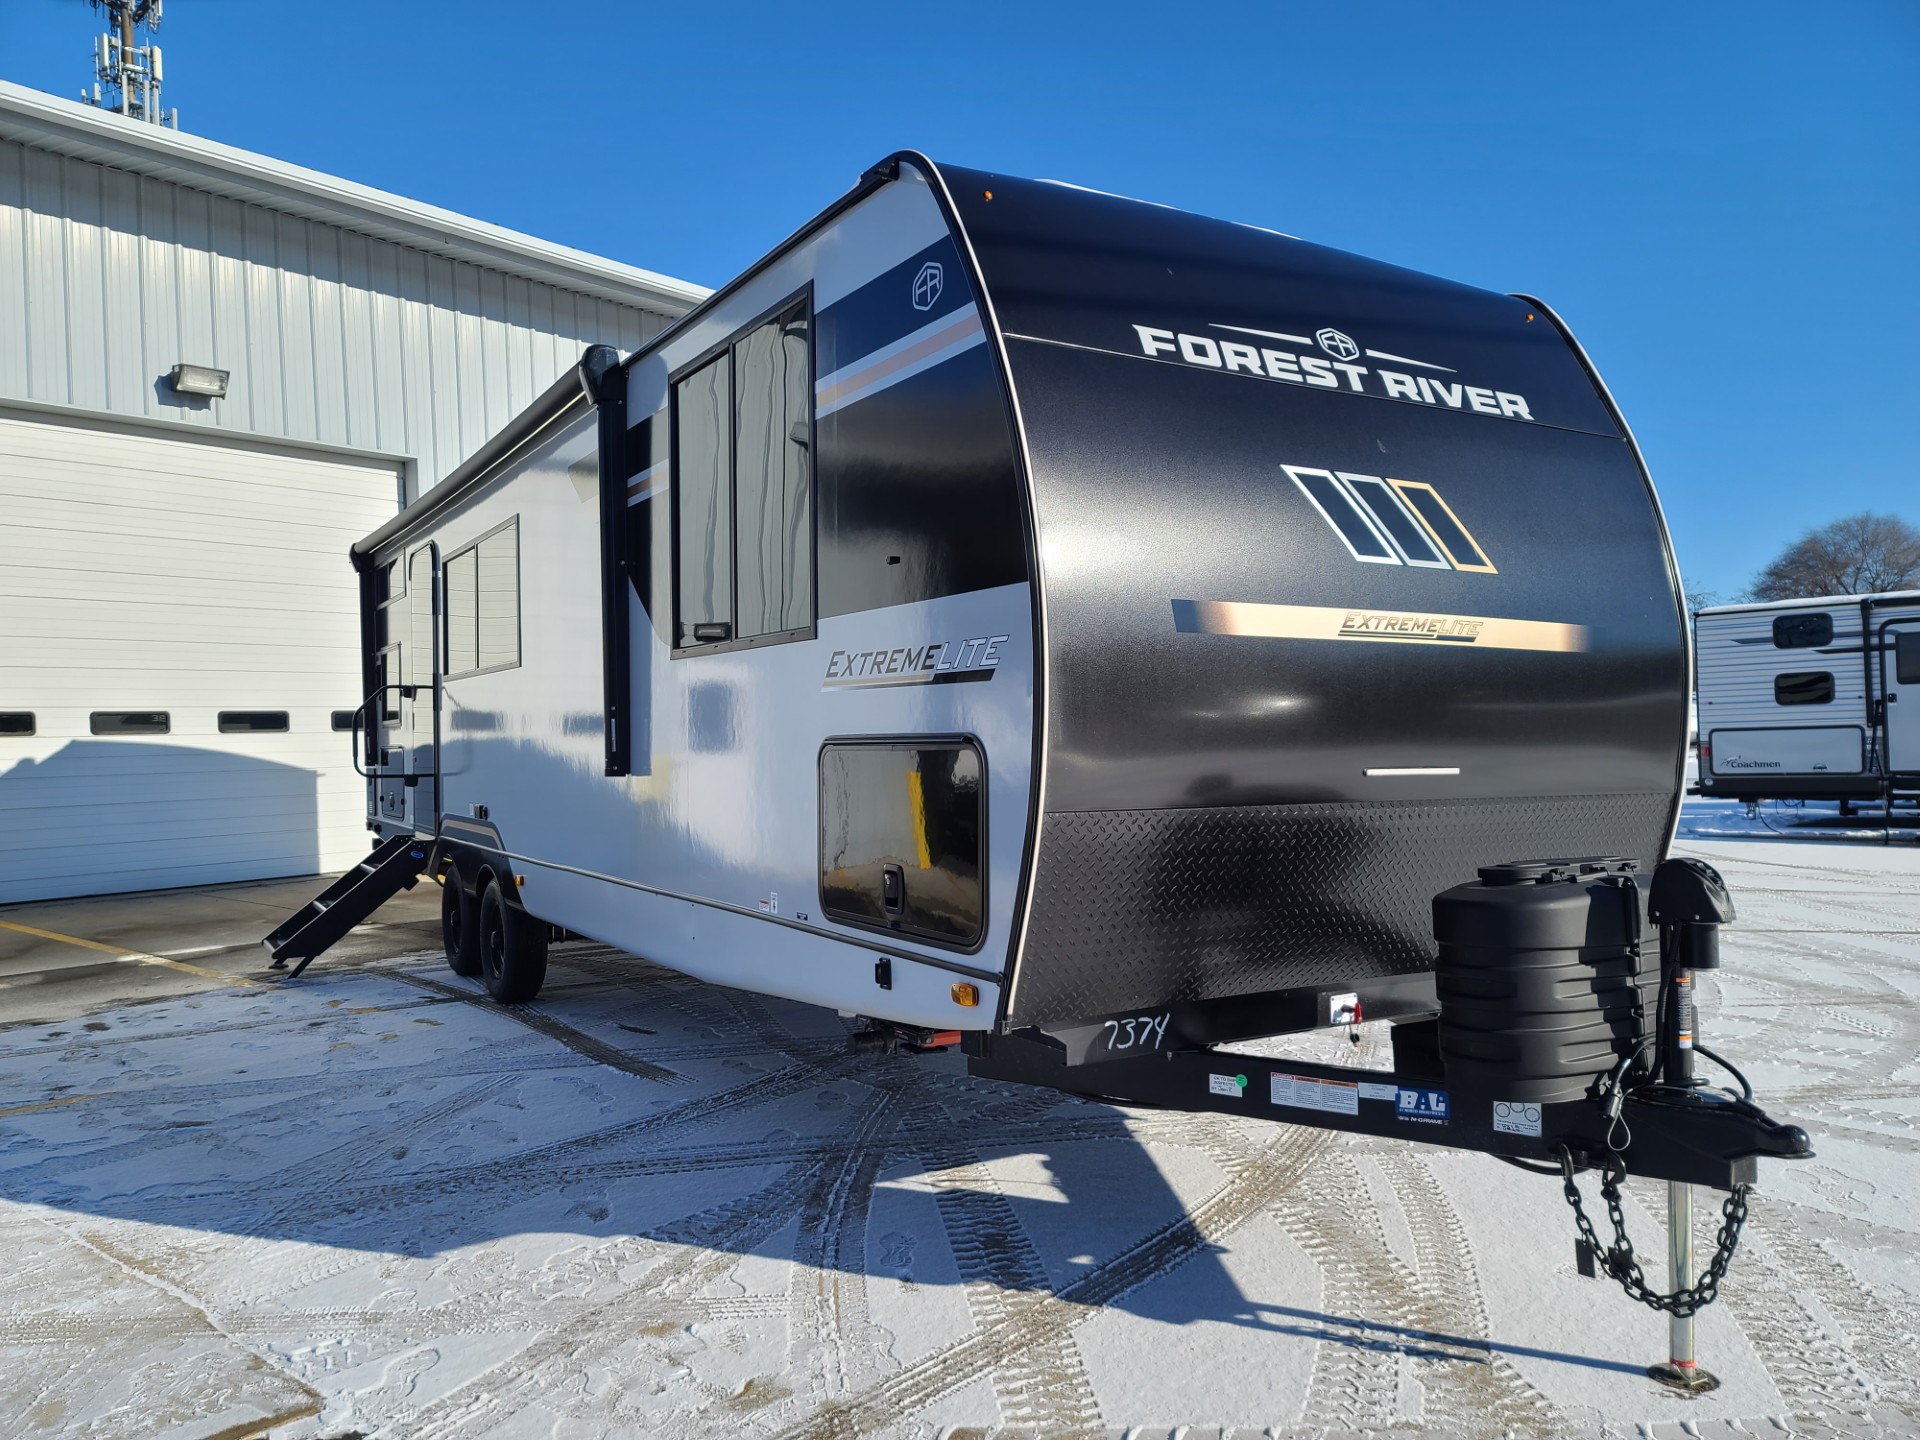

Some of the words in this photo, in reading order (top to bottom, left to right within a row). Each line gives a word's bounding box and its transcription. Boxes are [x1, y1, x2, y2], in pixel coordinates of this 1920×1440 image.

[1132, 324, 1369, 392] FOREST
[1376, 368, 1536, 421] RIVER
[1730, 760, 1781, 769] Coachmen
[1104, 1012, 1170, 1050] 7374
[1399, 1090, 1446, 1112] BAL
